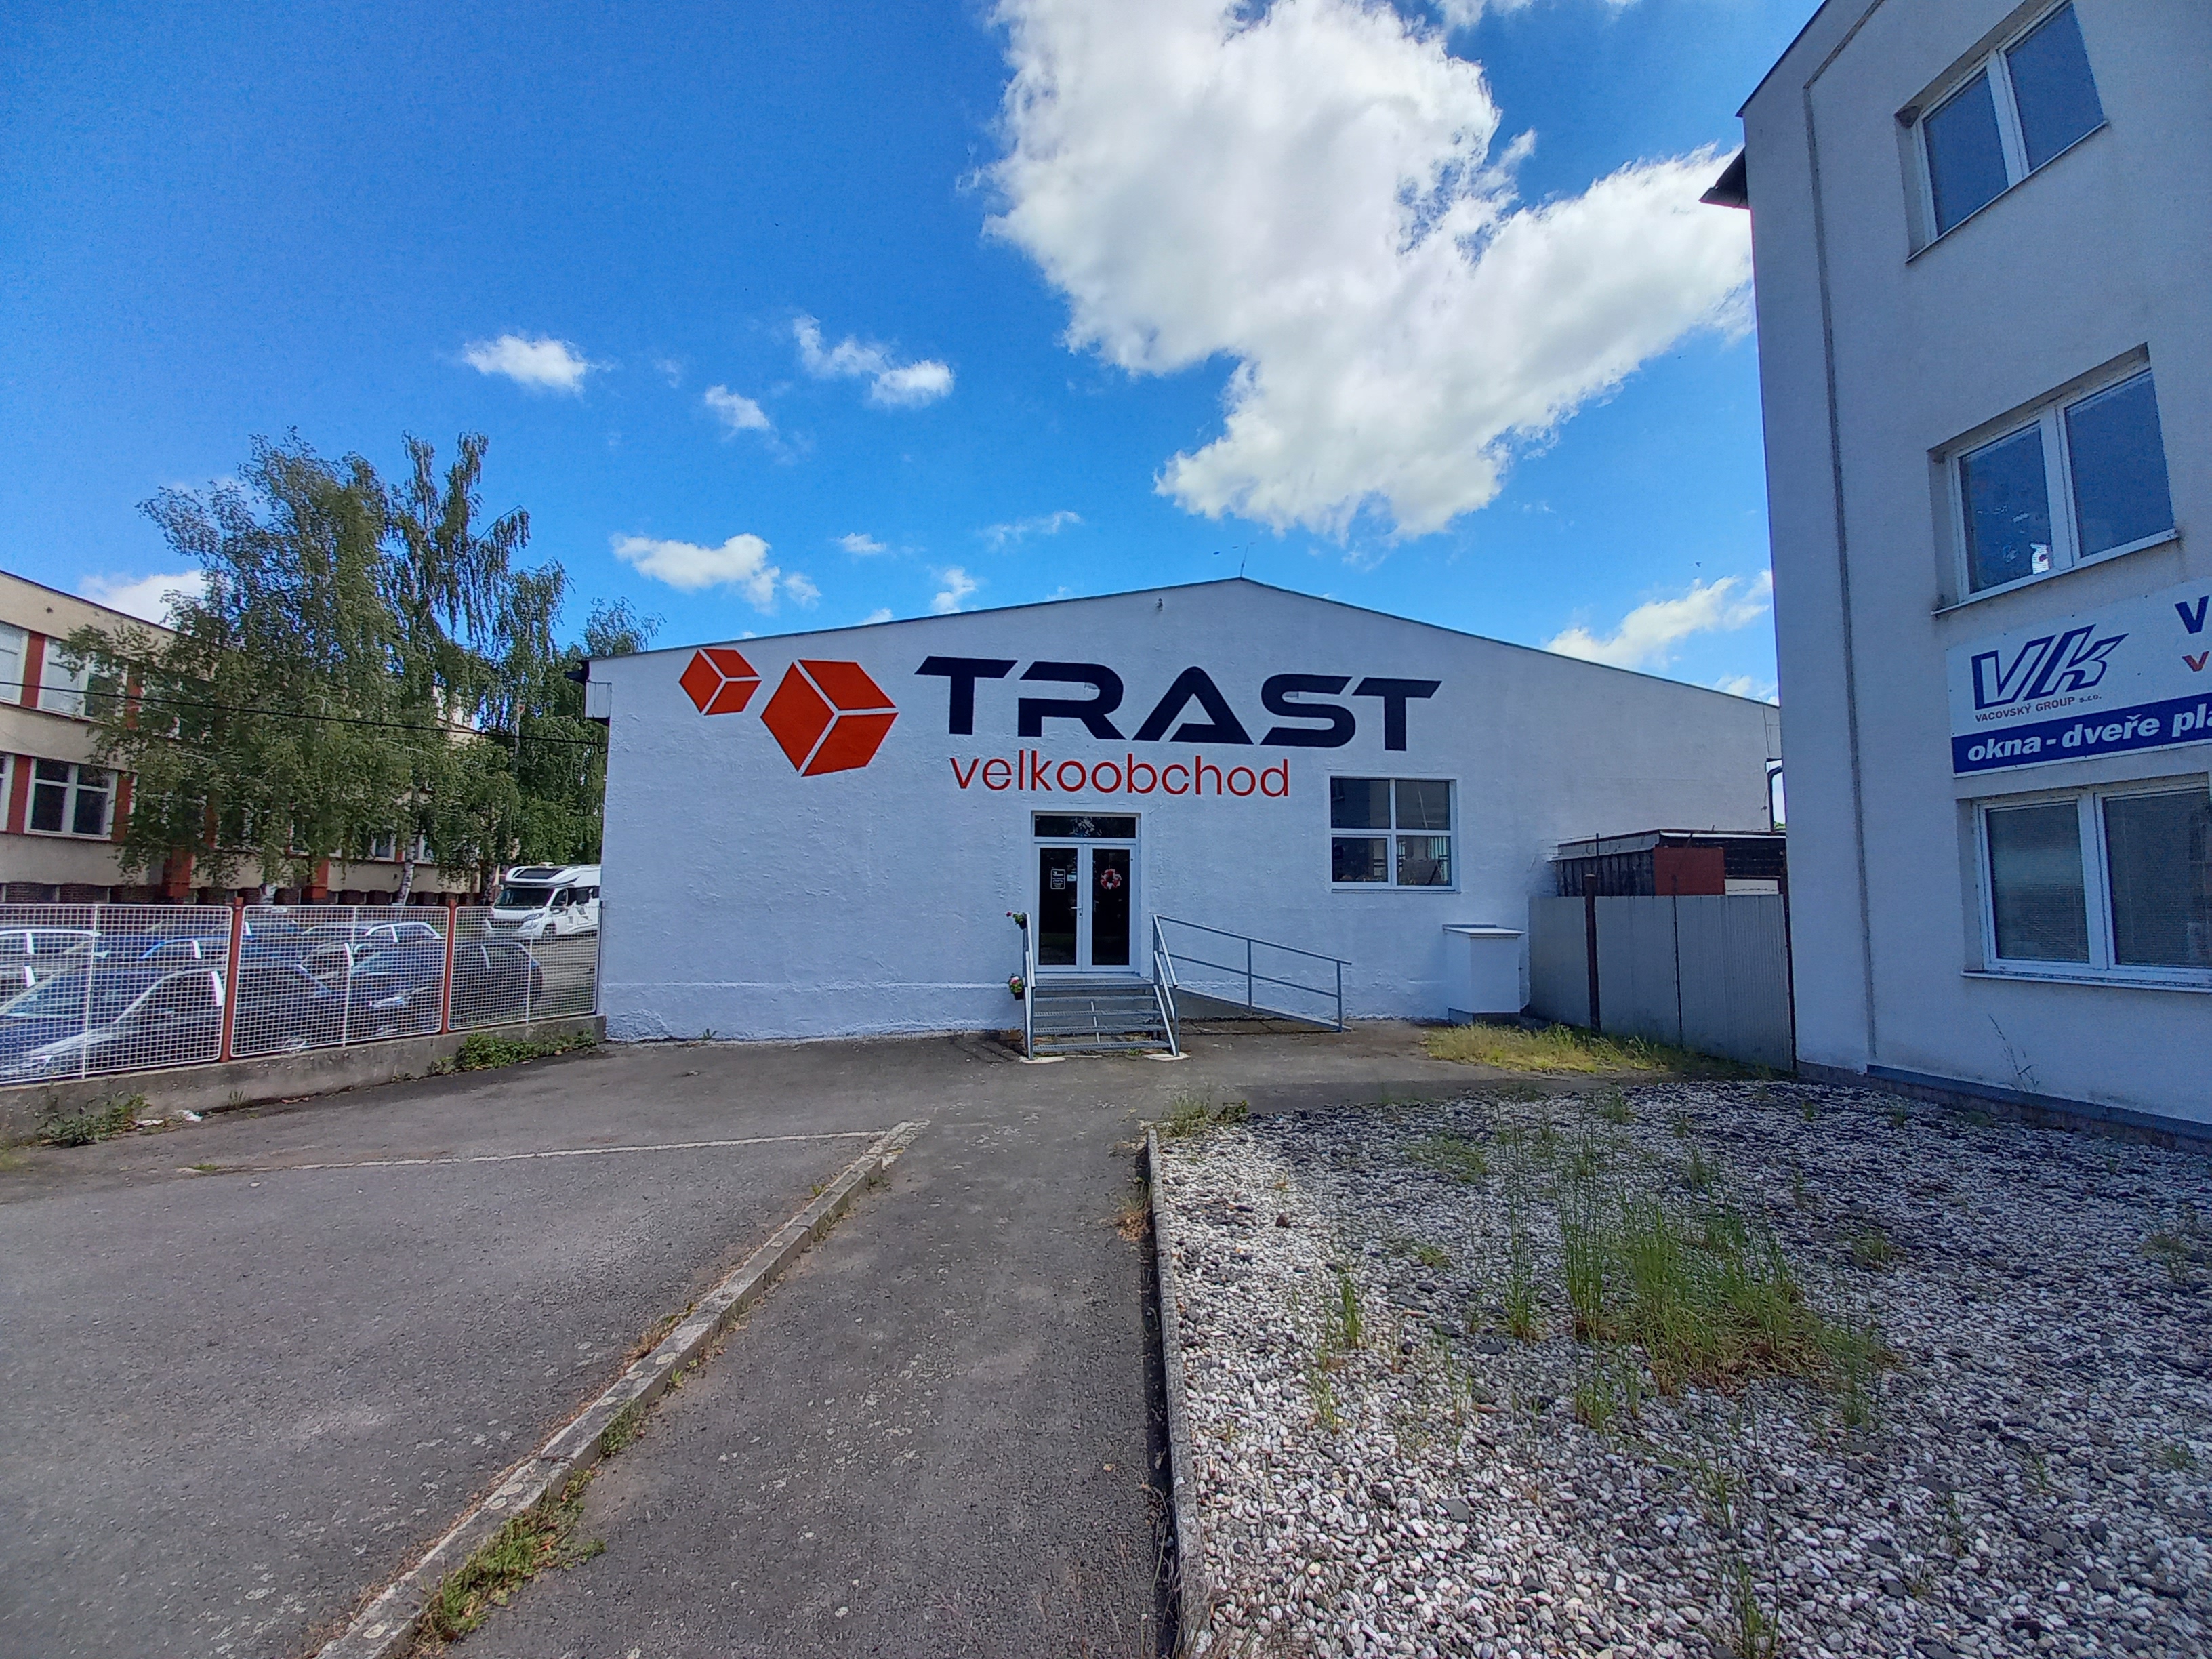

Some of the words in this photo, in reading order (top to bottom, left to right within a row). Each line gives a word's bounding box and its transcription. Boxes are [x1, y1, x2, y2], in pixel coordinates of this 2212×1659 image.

[914, 655, 1443, 752] TRAST
[1975, 702, 2032, 723] VACOVSKÝ
[2035, 696, 2075, 712] GROUP
[949, 750, 1289, 797] velkoobchod
